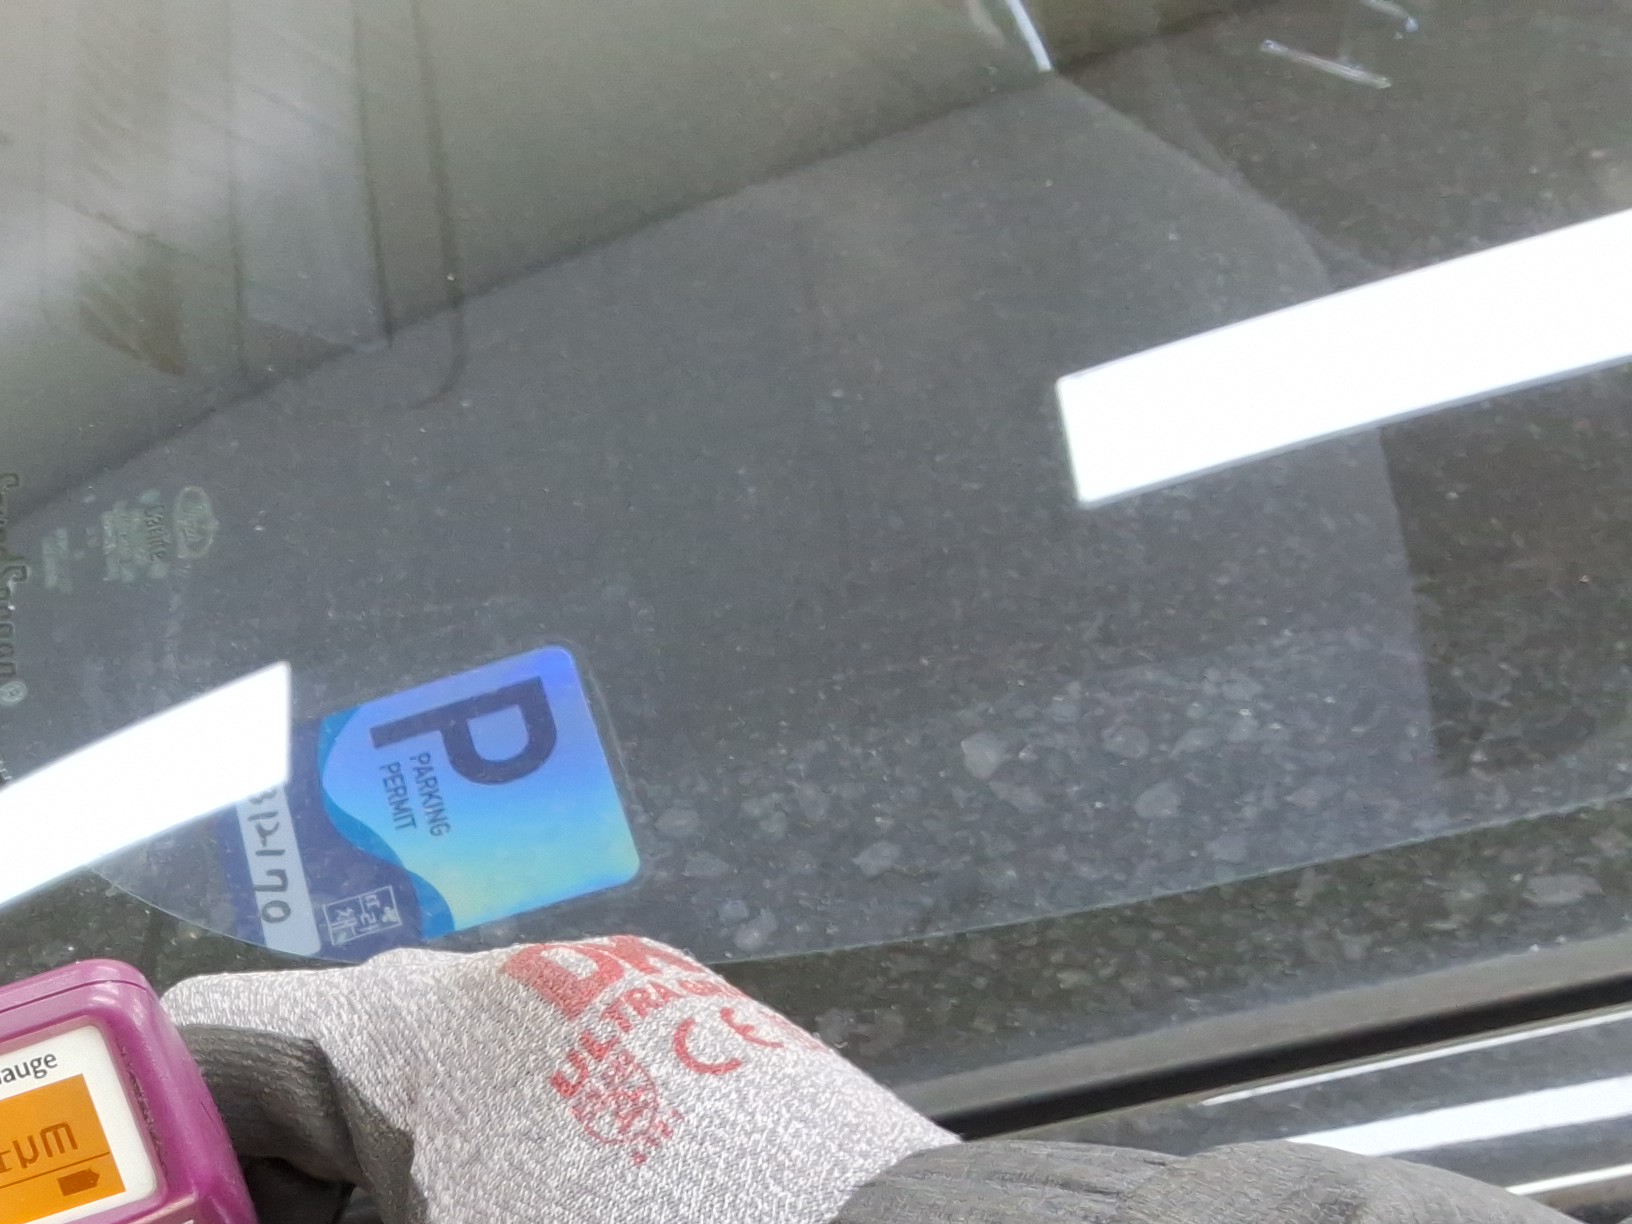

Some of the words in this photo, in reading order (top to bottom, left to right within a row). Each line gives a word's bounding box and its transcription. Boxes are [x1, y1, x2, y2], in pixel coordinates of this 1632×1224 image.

[370, 675, 558, 785] P
[380, 761, 418, 832] PERMIT
[409, 752, 452, 837] PARKING
